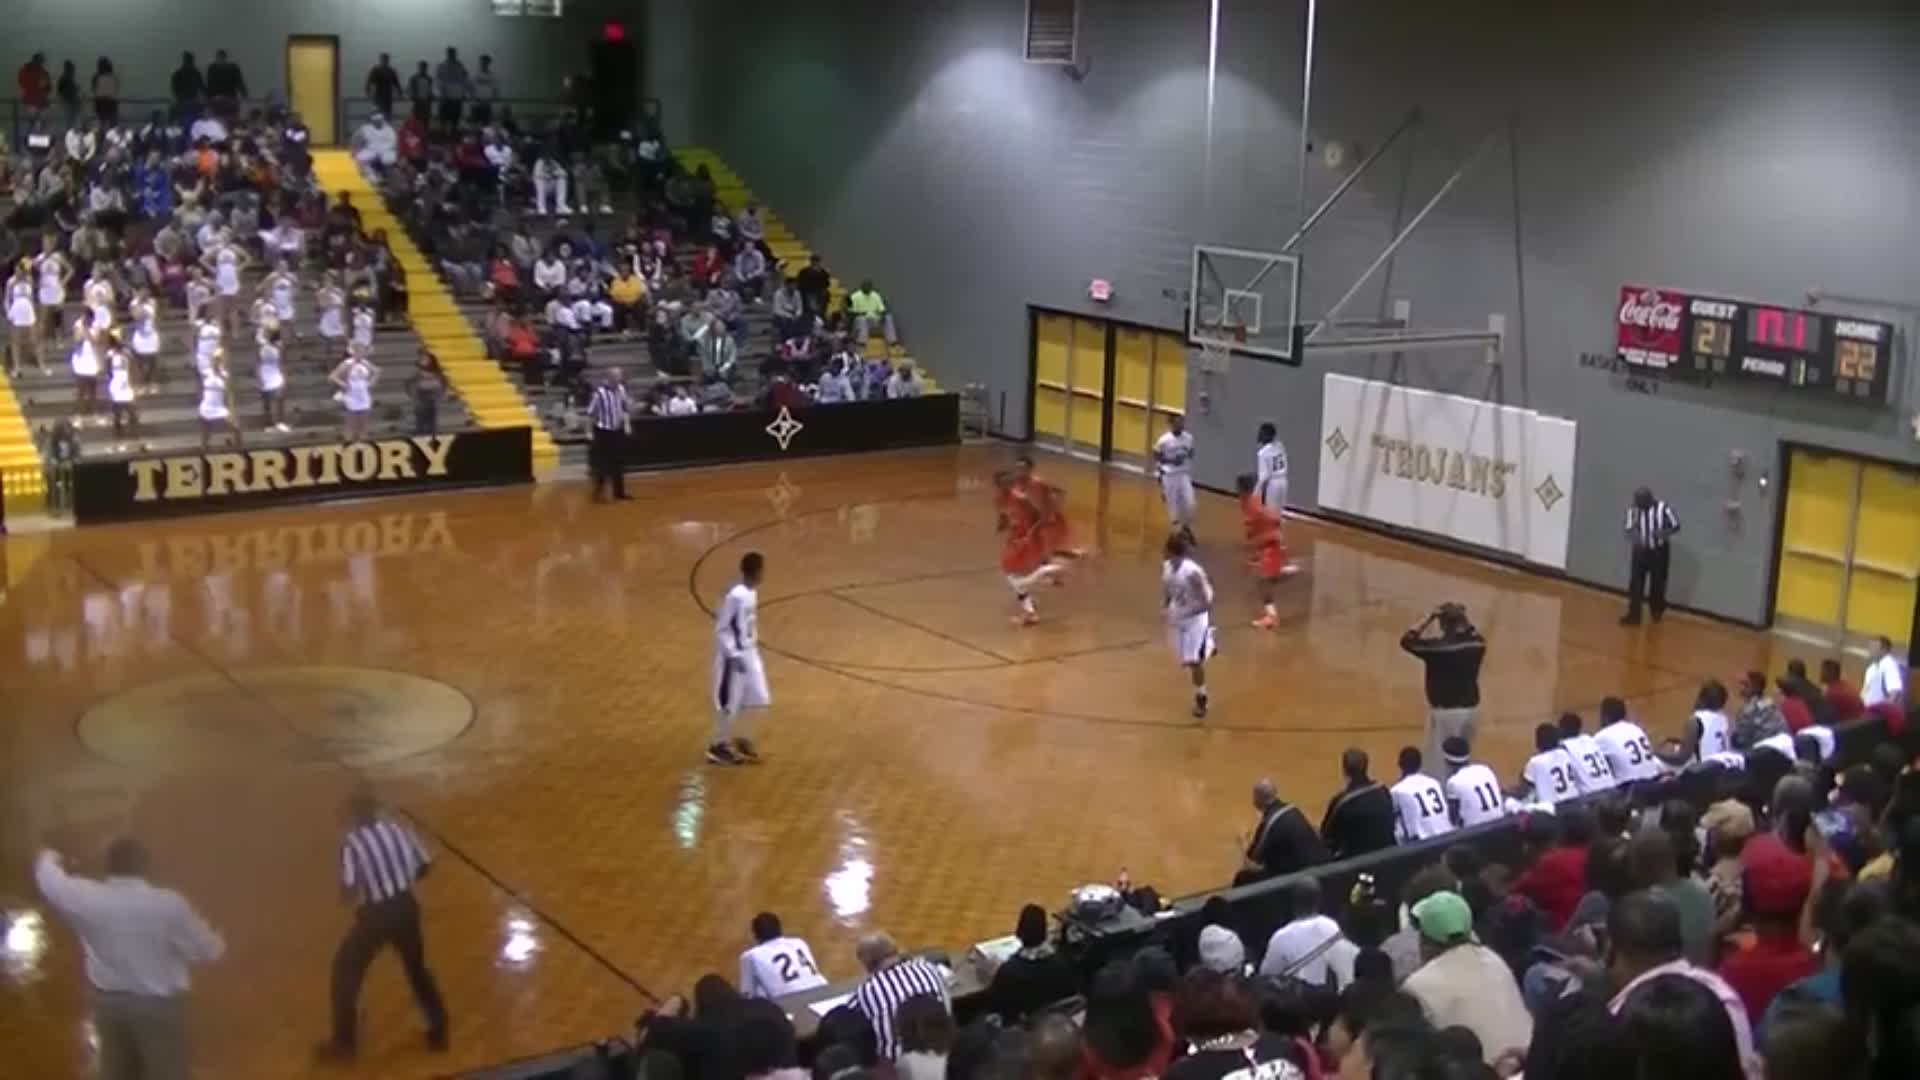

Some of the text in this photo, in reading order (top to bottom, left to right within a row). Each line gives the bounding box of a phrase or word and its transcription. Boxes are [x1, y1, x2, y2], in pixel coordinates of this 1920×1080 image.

[1741, 356, 1785, 377] PERIOD
[129, 434, 458, 502] TERRITORY
[1414, 787, 1444, 818] 13
[1474, 781, 1500, 812] 11
[773, 948, 816, 982] 24
